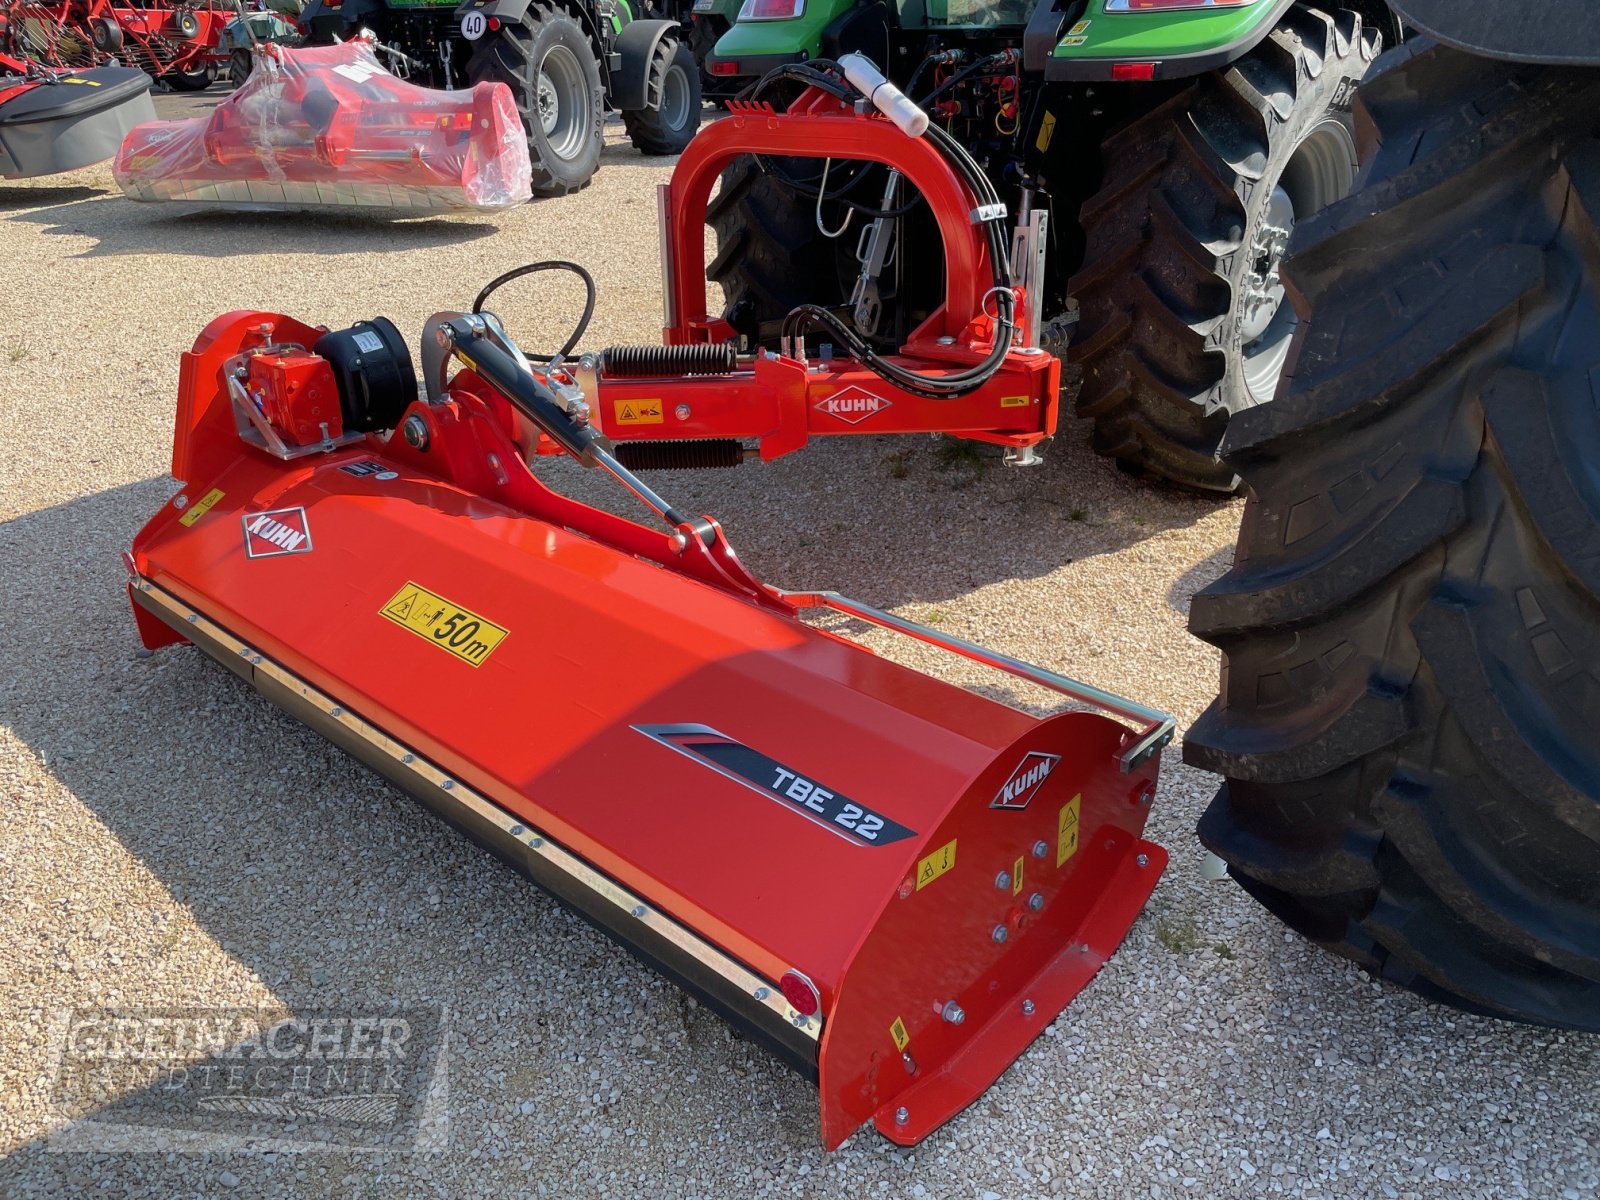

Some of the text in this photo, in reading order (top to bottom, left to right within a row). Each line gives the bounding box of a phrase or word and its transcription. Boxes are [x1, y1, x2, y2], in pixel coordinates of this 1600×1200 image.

[466, 16, 481, 34] 40
[828, 398, 879, 413] KUHN
[248, 515, 306, 552] KUHN
[1003, 757, 1050, 805] KUHN
[772, 766, 885, 840] TBE 22
